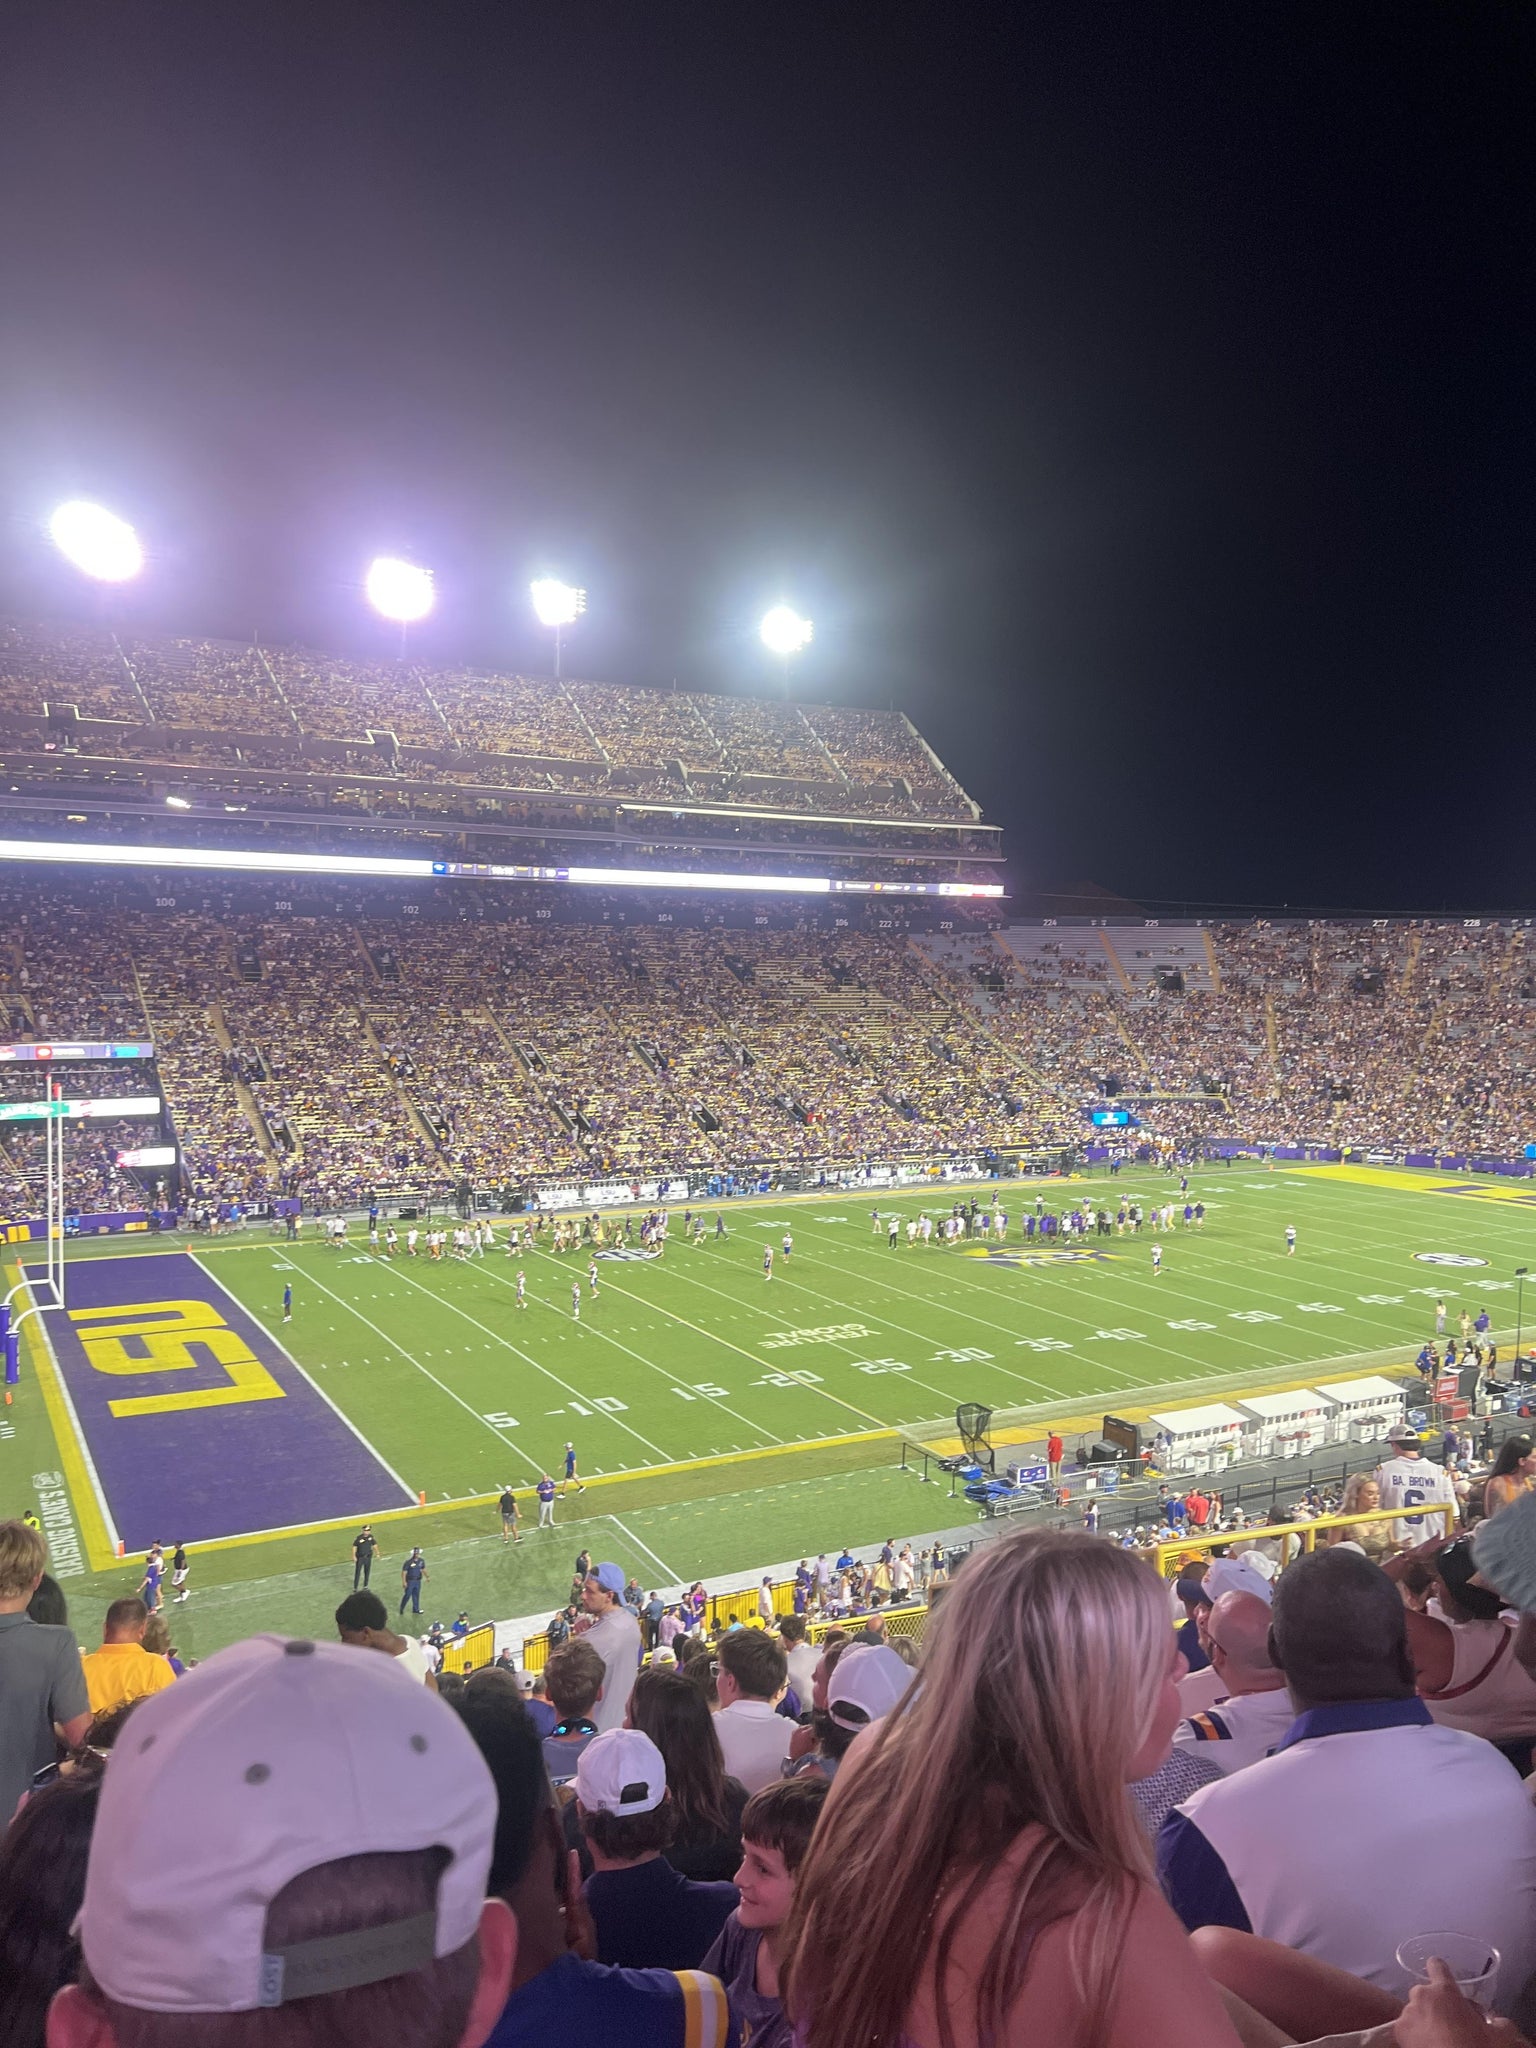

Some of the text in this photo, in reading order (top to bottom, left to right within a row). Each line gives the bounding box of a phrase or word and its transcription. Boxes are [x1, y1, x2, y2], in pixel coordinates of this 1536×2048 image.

[156, 898, 176, 907] 100
[275, 901, 292, 910] 101
[536, 910, 551, 918] 103
[658, 914, 673, 922] 104
[755, 917, 769, 925] 105
[879, 920, 892, 928] 222
[1144, 919, 1159, 927] 225
[1463, 919, 1481, 928] 228
[271, 1263, 295, 1271] 5
[1408, 1287, 1461, 1298] 35
[1356, 1294, 1402, 1305] 40
[1296, 1302, 1345, 1313] 45
[1227, 1310, 1283, 1323] 50
[764, 1323, 867, 1340] GLOBAL
[1166, 1319, 1218, 1331] 45
[757, 1329, 883, 1349] VENTURE
[1096, 1328, 1148, 1341] 40
[1014, 1337, 1074, 1352] 35
[66, 1300, 288, 1418] LSU
[935, 1347, 996, 1363] 30
[850, 1358, 913, 1375] 25
[761, 1370, 825, 1388] 20
[670, 1382, 731, 1401] 15
[567, 1396, 630, 1416] 10
[482, 1411, 521, 1429] 5
[1392, 1475, 1436, 1487] BA. BROWN
[38, 1490, 73, 1528] CANE'S
[1404, 1489, 1426, 1525] 6
[46, 1527, 85, 1580] RAISING
